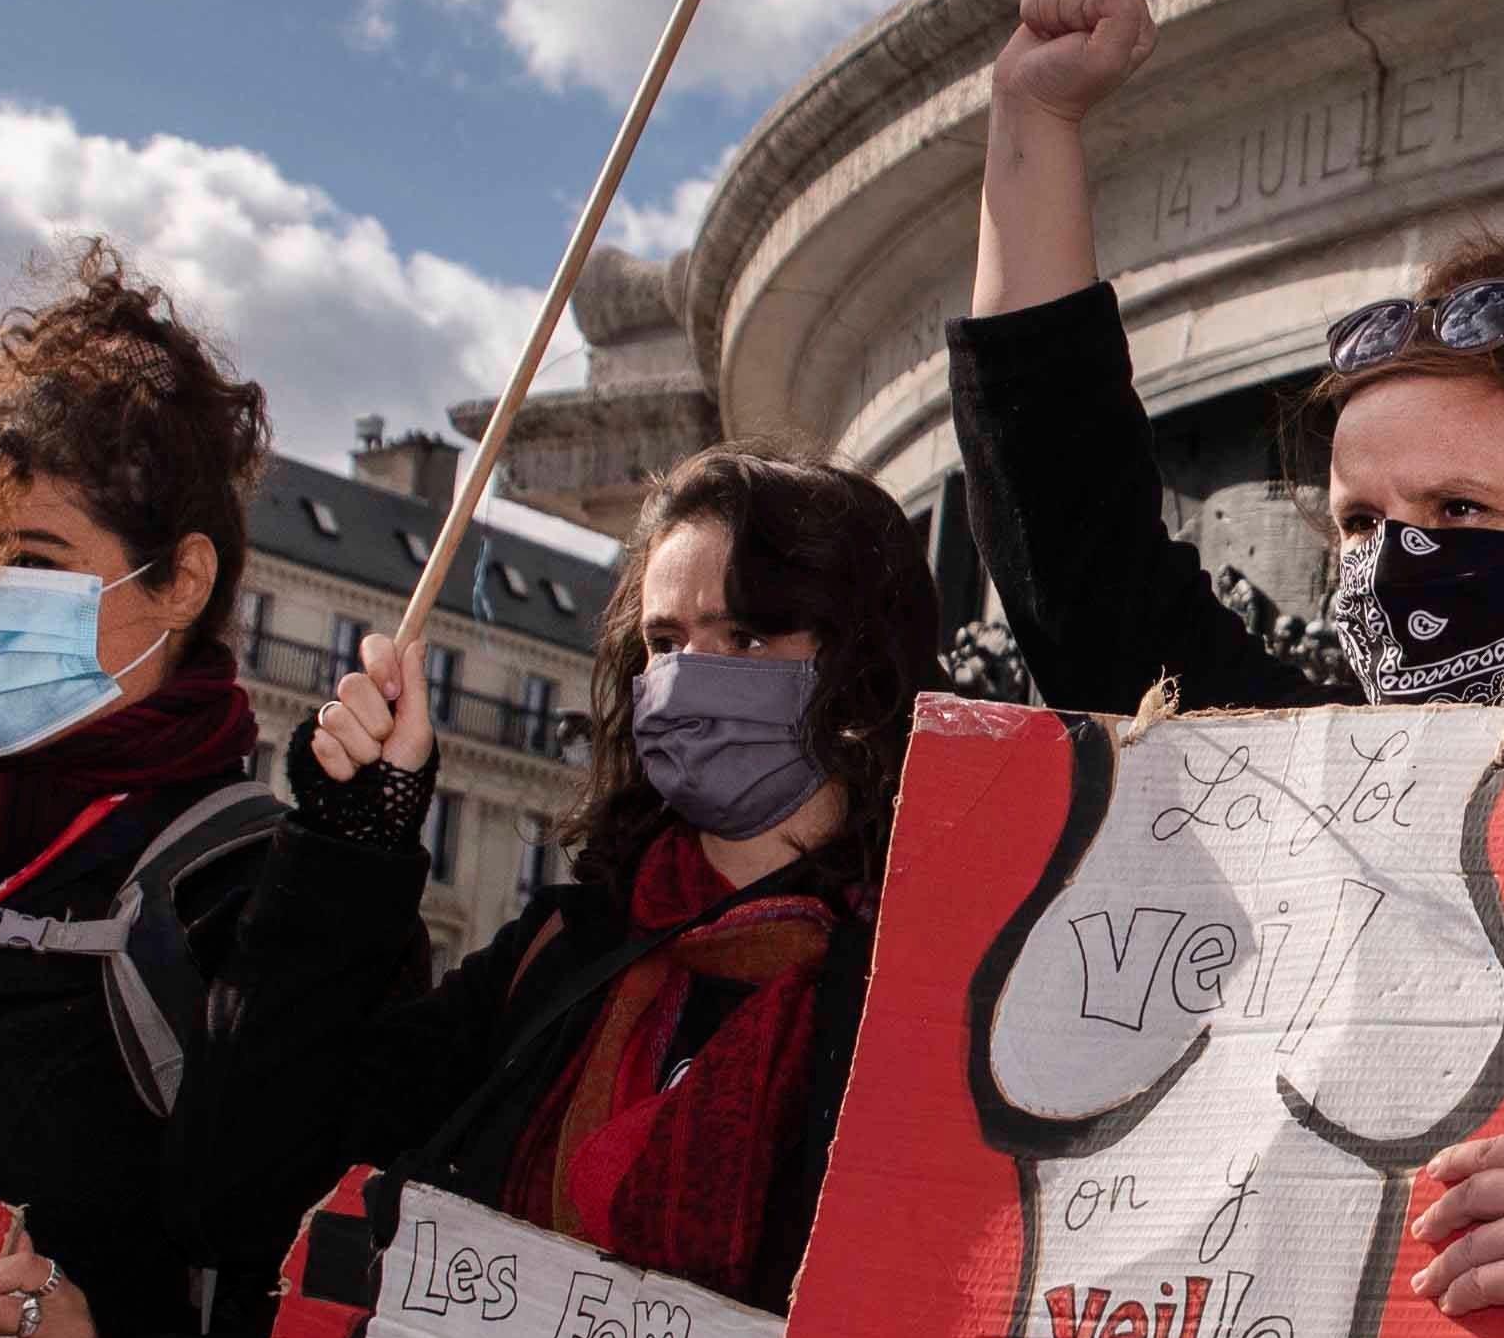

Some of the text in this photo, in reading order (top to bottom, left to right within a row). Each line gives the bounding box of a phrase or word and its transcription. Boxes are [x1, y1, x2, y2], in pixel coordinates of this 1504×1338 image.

[1151, 168, 1196, 242] 14
[1215, 59, 1480, 217] JUILLET
[1151, 745, 1276, 843] La
[1064, 1167, 1148, 1233] on
[402, 1220, 518, 1321] Les
